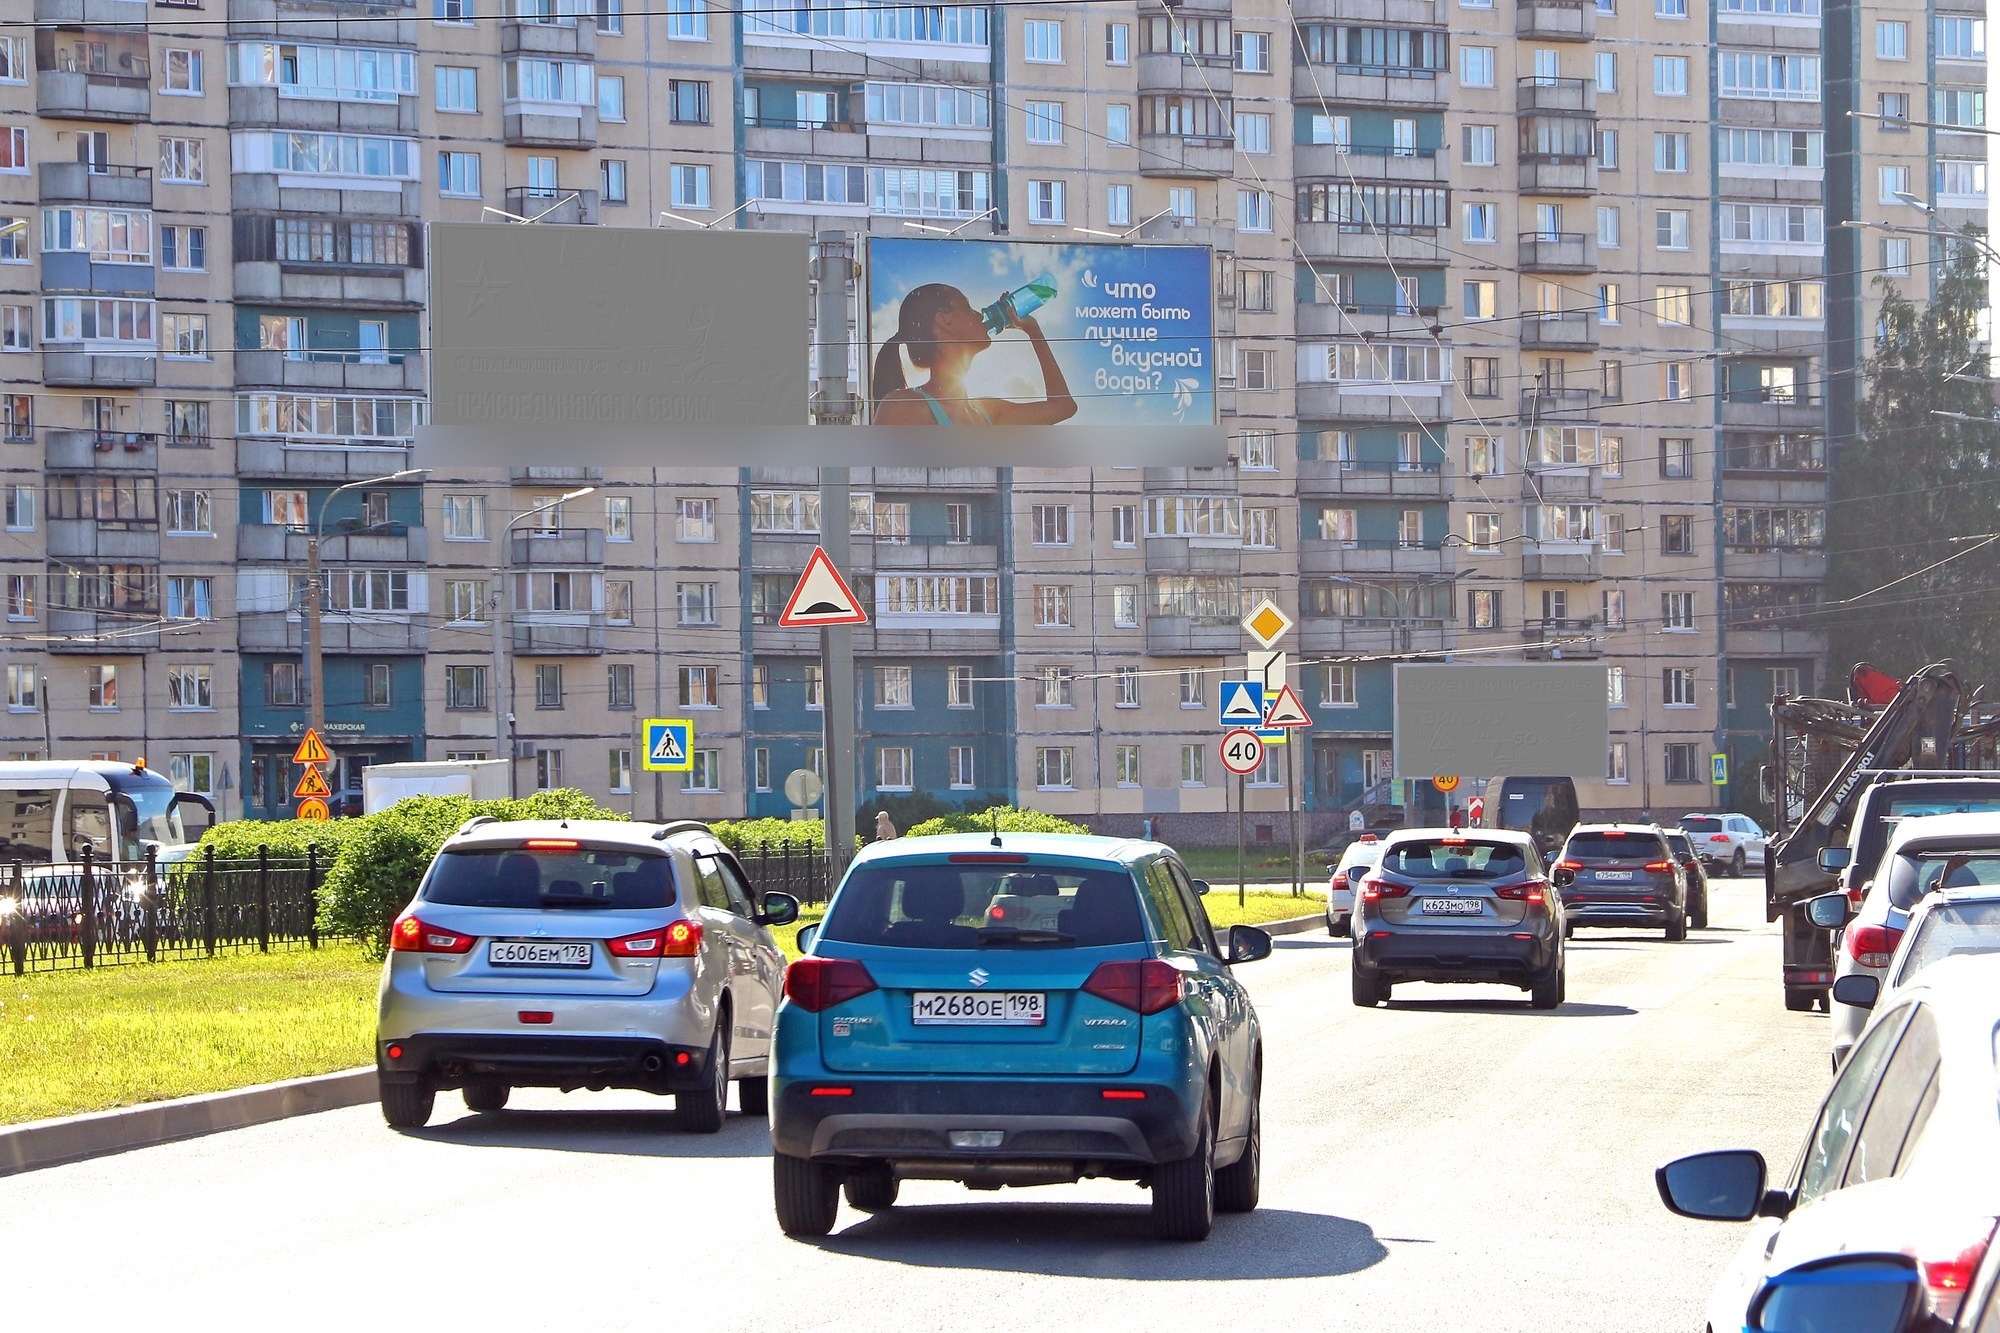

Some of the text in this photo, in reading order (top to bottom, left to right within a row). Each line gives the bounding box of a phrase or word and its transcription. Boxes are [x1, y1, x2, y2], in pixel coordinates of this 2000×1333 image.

[1104, 282, 1156, 299] что
[1075, 302, 1191, 320] может быть
[1084, 325, 1158, 347] лучше
[1111, 343, 1202, 373] вкусной
[1094, 368, 1163, 395] воды?
[1228, 742, 1257, 761] 40
[1834, 769, 1860, 803] ATLAS
[304, 808, 322, 820] 40
[1425, 900, 1480, 910] К623МО 198
[494, 945, 586, 961] С606ЕМ 178
[919, 995, 1038, 1016] М268ОЕ 198
[833, 1016, 873, 1024] SUZUKI
